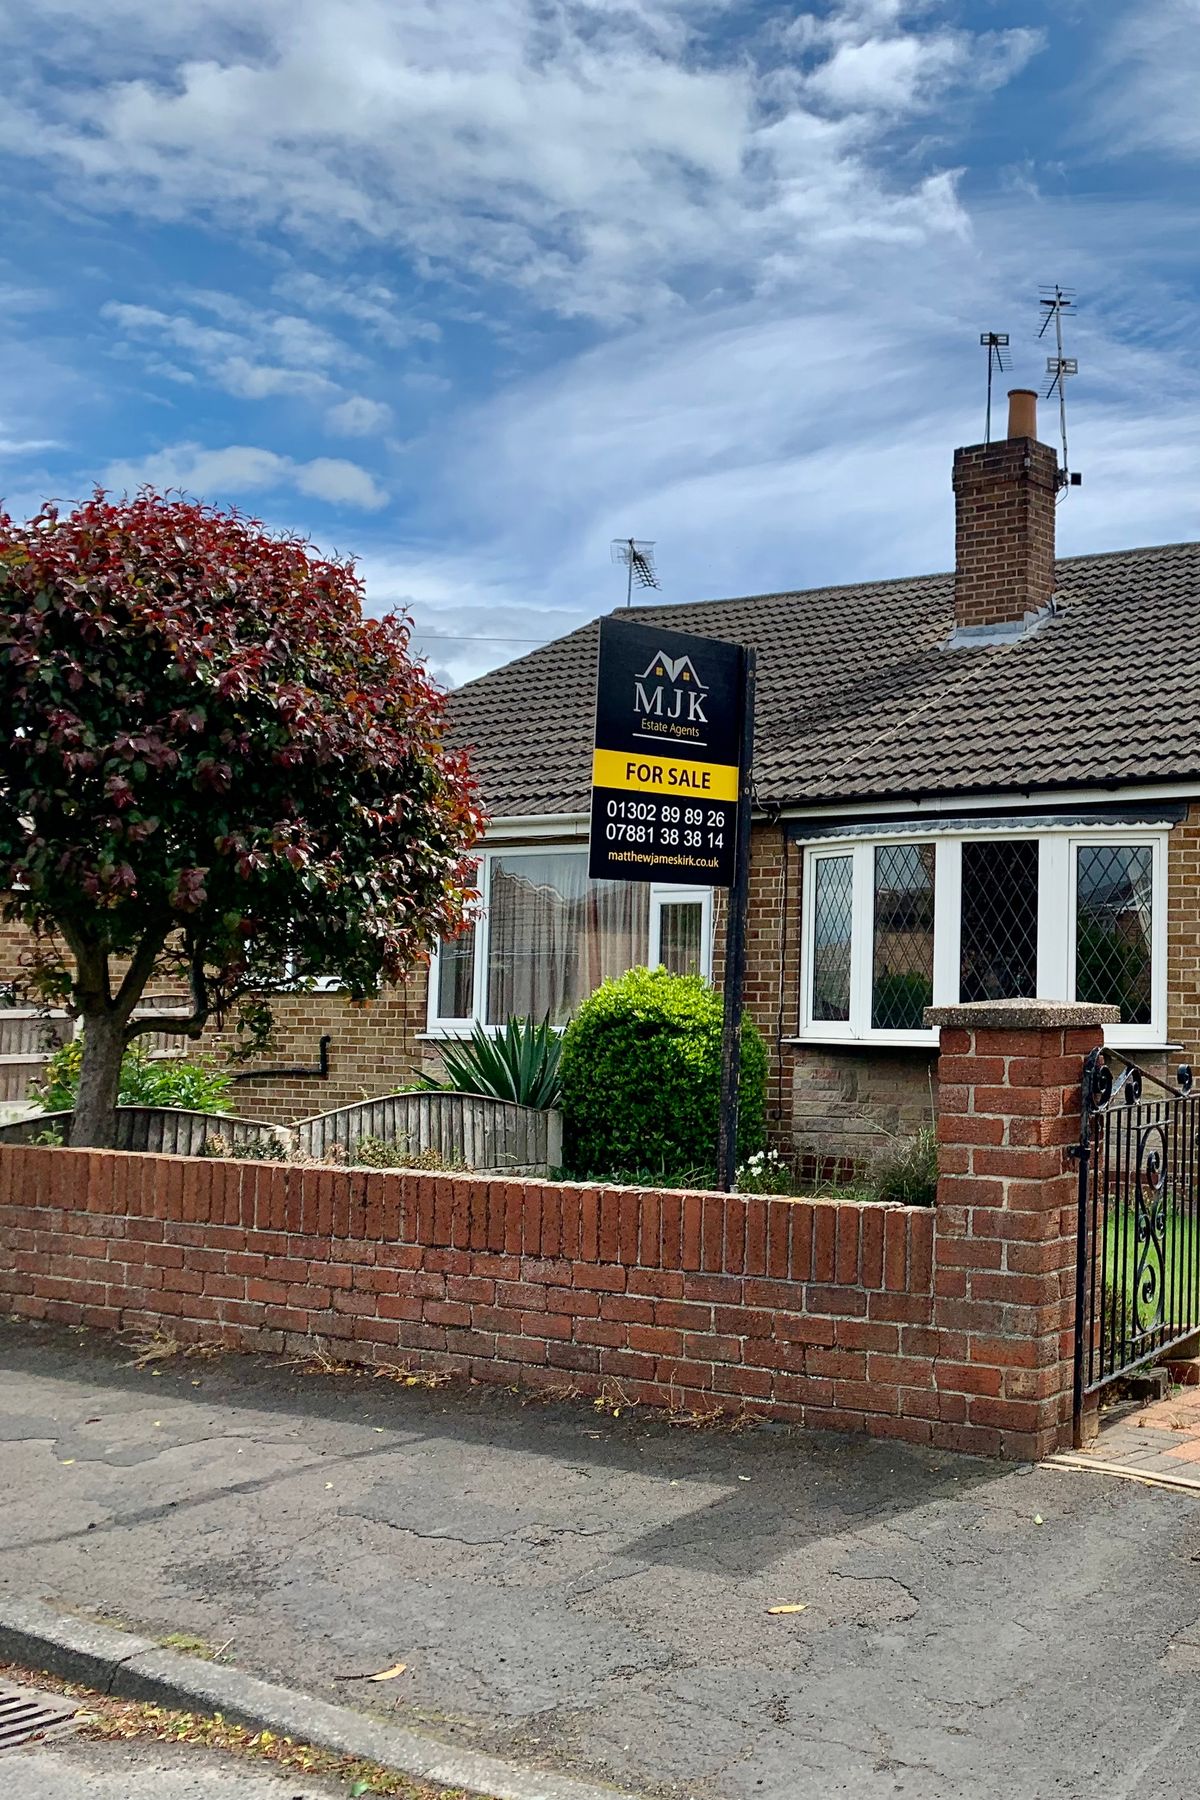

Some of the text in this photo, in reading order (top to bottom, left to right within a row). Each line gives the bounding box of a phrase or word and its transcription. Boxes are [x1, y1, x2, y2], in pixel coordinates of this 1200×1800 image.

[633, 681, 708, 723] MJK
[641, 718, 700, 737] Estate Agents
[626, 762, 711, 790] FOR SALE
[607, 800, 725, 828] 01302 89 89 26
[606, 823, 724, 849] 07881 38 38 14
[608, 850, 719, 868] matthewjameskirk.co.uk
